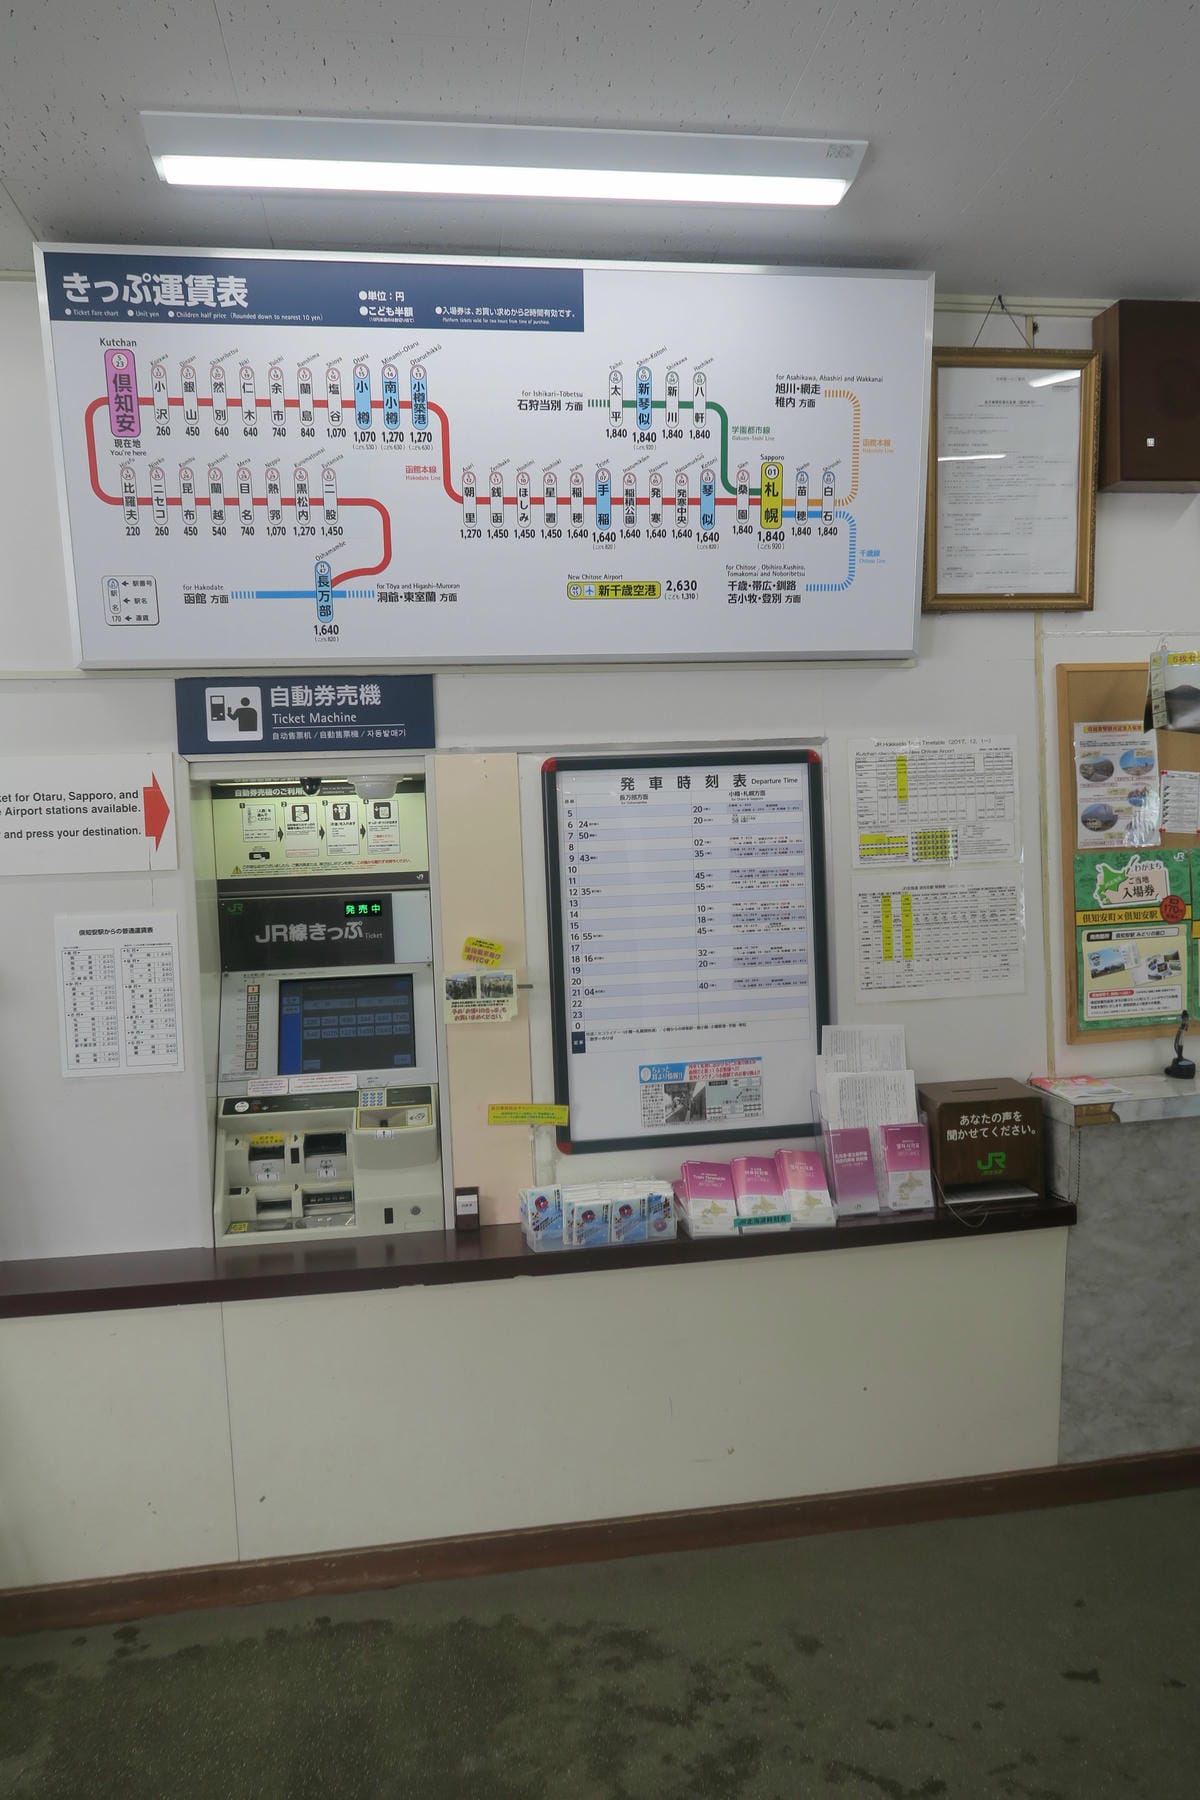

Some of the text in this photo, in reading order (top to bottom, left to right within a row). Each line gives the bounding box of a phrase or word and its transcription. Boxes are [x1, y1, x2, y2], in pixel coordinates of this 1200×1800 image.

[62, 272, 249, 308] きっぷ運賃表
[368, 306, 413, 317] こども半額
[100, 337, 137, 348] Kutchan
[775, 383, 821, 395] 旭川・網走
[112, 373, 135, 433] 倶知安
[384, 381, 398, 424] 南小樽
[517, 399, 583, 411] 石狩当別 方面
[638, 383, 650, 425] 新琴似
[775, 396, 816, 408] 稚内 方面
[156, 427, 171, 436] 260
[186, 427, 200, 436] 450
[243, 427, 258, 437] 640
[272, 427, 286, 437] 740
[606, 428, 627, 438] 1,840
[632, 431, 657, 443] 1,840
[662, 429, 683, 439] 1,840
[689, 429, 710, 439] 1,840
[353, 431, 376, 444] 1,070
[382, 431, 404, 444] 1,270
[409, 431, 432, 444] 1,270
[114, 439, 141, 449] 現在地
[760, 454, 785, 462] Sapporo
[153, 484, 166, 520] ニセコ
[519, 487, 529, 523] ほしみ
[598, 484, 609, 526] 手稲
[764, 482, 779, 523] 札幌
[823, 486, 833, 522] 白石
[125, 527, 141, 536] 220
[155, 527, 169, 536] 260
[183, 527, 198, 536] 450
[240, 527, 255, 536] 740
[293, 527, 316, 537] 1,270
[321, 527, 343, 537] 1,450
[460, 529, 481, 539] 1,270
[514, 529, 535, 539] 1,450
[645, 529, 667, 539] 1,640
[757, 531, 785, 542] 1,840
[818, 527, 838, 536] 1,840
[592, 532, 616, 543] 1,640
[696, 532, 720, 543] 1,640
[598, 584, 657, 597] 新千歳空港
[665, 579, 697, 592] 2,630
[727, 580, 796, 591] 千歳・帯広・釧路
[184, 593, 229, 604] 函館 方面
[317, 575, 331, 617] 長万部
[440, 593, 457, 602] 方面
[727, 593, 801, 604] 苫小牧・登別 方面
[313, 625, 339, 636] 1,640
[270, 684, 381, 708] 自動券売機
[272, 713, 357, 724] Ticket Machine
[751, 777, 781, 785] Departure
[15, 790, 139, 802] for Otaru, Sapporo, and
[5, 804, 141, 817] Airport stations available.
[693, 805, 702, 813] 20
[579, 820, 588, 828] 24
[694, 816, 703, 824] 20
[4, 826, 141, 840] and press your destination.
[579, 831, 589, 840] 50
[569, 839, 704, 851] 8 02
[579, 854, 590, 862] 43
[695, 850, 704, 858] 35
[1134, 862, 1162, 873] わがまち
[568, 872, 705, 885] 11 45
[569, 883, 705, 896] 12 35 55
[1123, 885, 1155, 899] 入場券
[346, 905, 381, 915] 発売中
[570, 922, 579, 930] 15
[255, 921, 364, 943] JR線きっぷ
[571, 927, 707, 941] 16 55 45
[571, 944, 580, 952] 17
[571, 955, 580, 963] 18
[585, 988, 594, 996] 04
[699, 982, 709, 990] 40
[572, 1000, 582, 1008] 22
[573, 1011, 583, 1019] 23
[575, 1022, 581, 1030] 0
[960, 1111, 1022, 1125] あなたの声を
[947, 1124, 1037, 1141] 聞かせてください。
[977, 1152, 1007, 1169] JR
